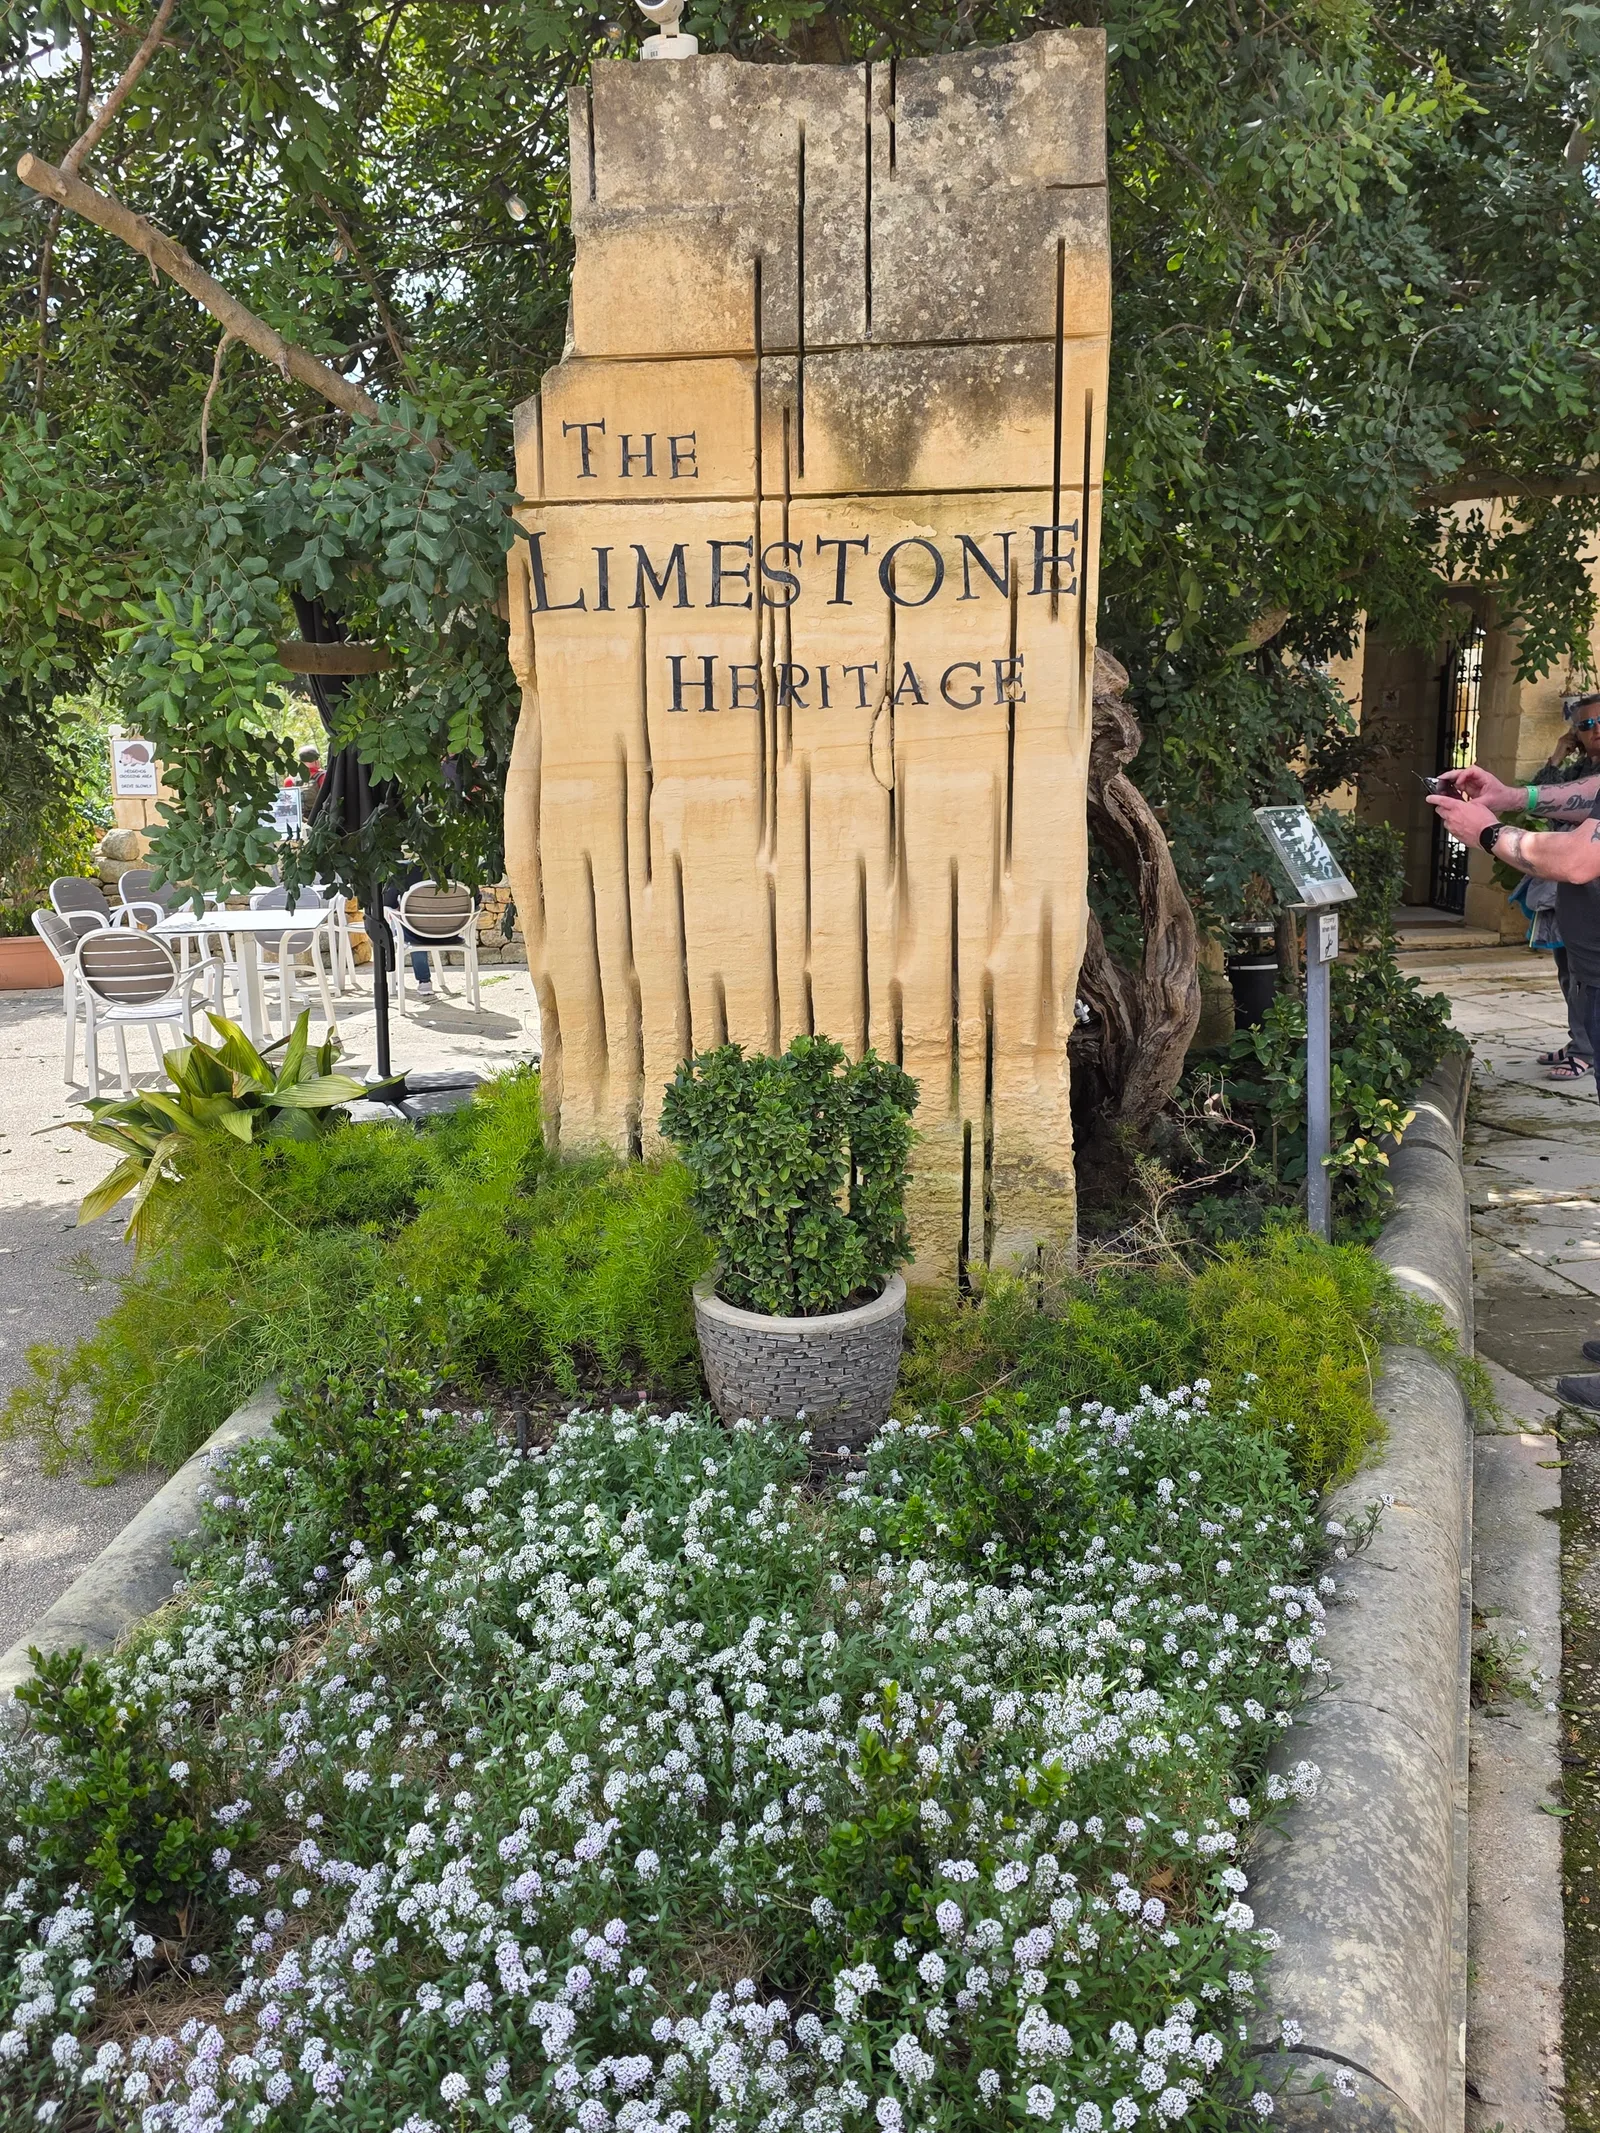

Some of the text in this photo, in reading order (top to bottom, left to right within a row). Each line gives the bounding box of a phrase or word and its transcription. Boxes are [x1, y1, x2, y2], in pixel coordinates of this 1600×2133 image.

[562, 417, 699, 479] THE
[529, 518, 1079, 613] LIMESTONE
[665, 653, 1027, 713] HERITAGE
